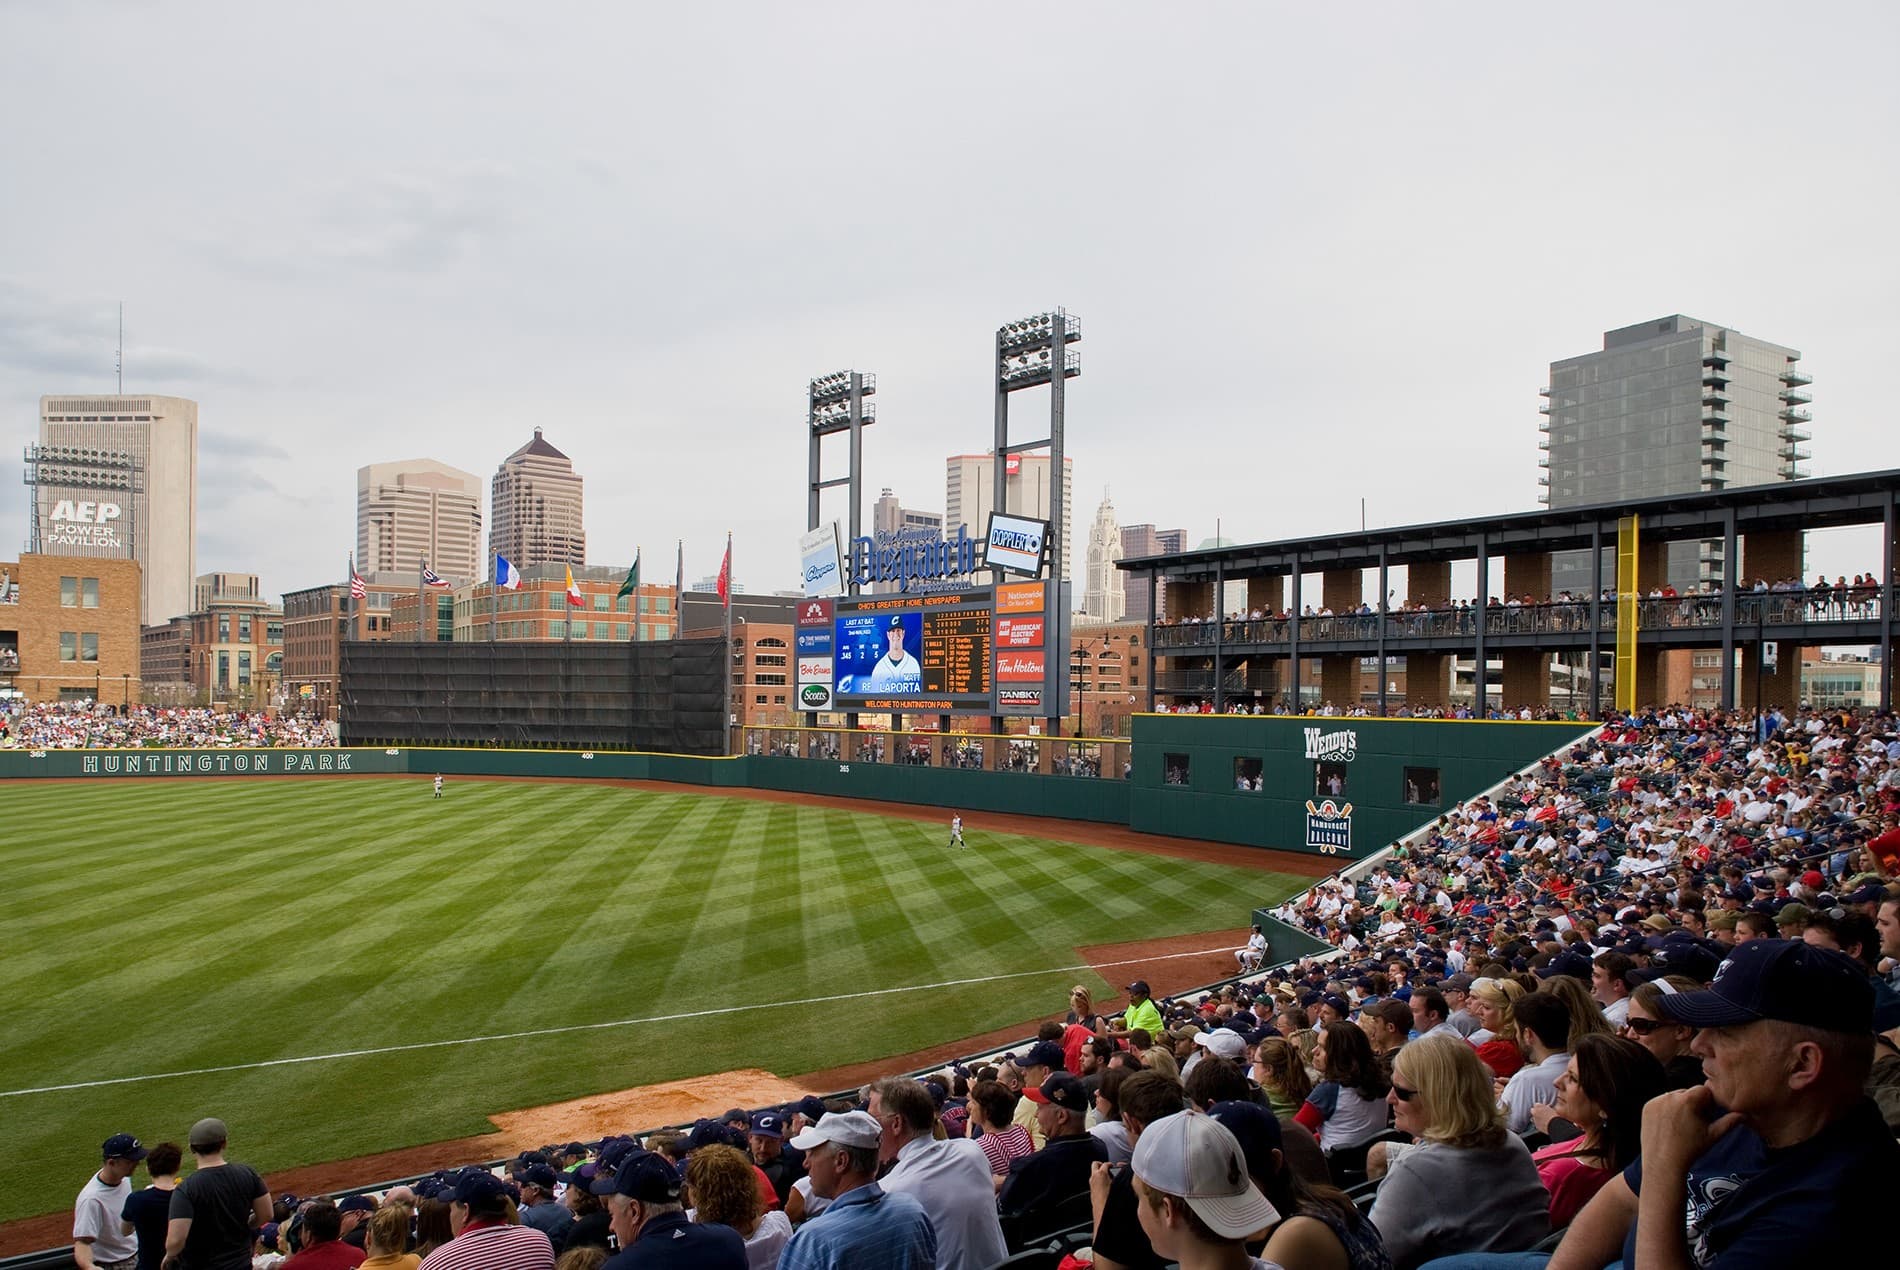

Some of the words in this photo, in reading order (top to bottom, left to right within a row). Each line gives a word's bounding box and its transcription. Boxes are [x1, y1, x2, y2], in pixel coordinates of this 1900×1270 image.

[48, 500, 121, 523] AEP
[55, 524, 114, 536] POWER
[47, 535, 121, 547] PAVILION
[849, 523, 975, 593] Dispatch
[877, 600, 905, 609] GREATEST
[906, 599, 922, 607] HOME
[924, 596, 960, 606] NEWSPAPER
[800, 664, 813, 675] Bob
[997, 659, 1012, 673] Tim
[1013, 659, 1044, 673] Hortons
[880, 682, 920, 693] LAPORTA
[804, 689, 827, 700] Scotts
[1000, 690, 1040, 699] TANSKY
[865, 700, 891, 708] WELCOME
[892, 700, 899, 708] TO
[900, 700, 936, 709] HUNTINGTON
[936, 700, 953, 709] PARK
[1304, 727, 1357, 759] Wendy's
[83, 754, 268, 773] HUNTINGTON
[284, 754, 351, 771] PARK
[1311, 818, 1348, 830] HAMBURGER
[760, 1116, 774, 1128] C
